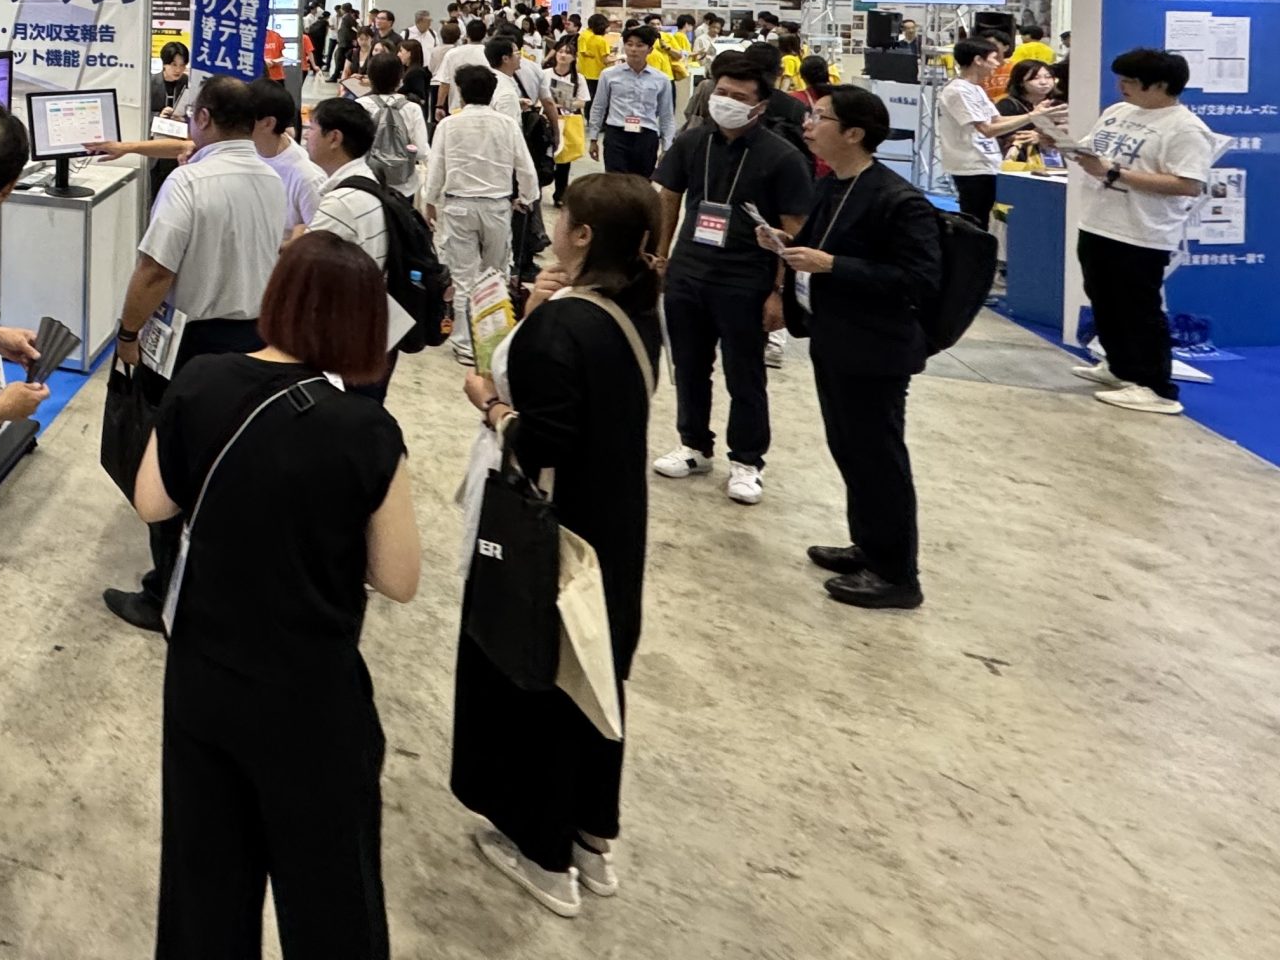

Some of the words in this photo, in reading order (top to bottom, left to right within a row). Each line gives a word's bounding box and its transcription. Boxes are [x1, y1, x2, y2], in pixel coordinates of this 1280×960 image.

[86, 53, 135, 69] etc...
[1185, 104, 1279, 116] 上げ交渉がスムーズに
[1094, 129, 1146, 165] 賃料
